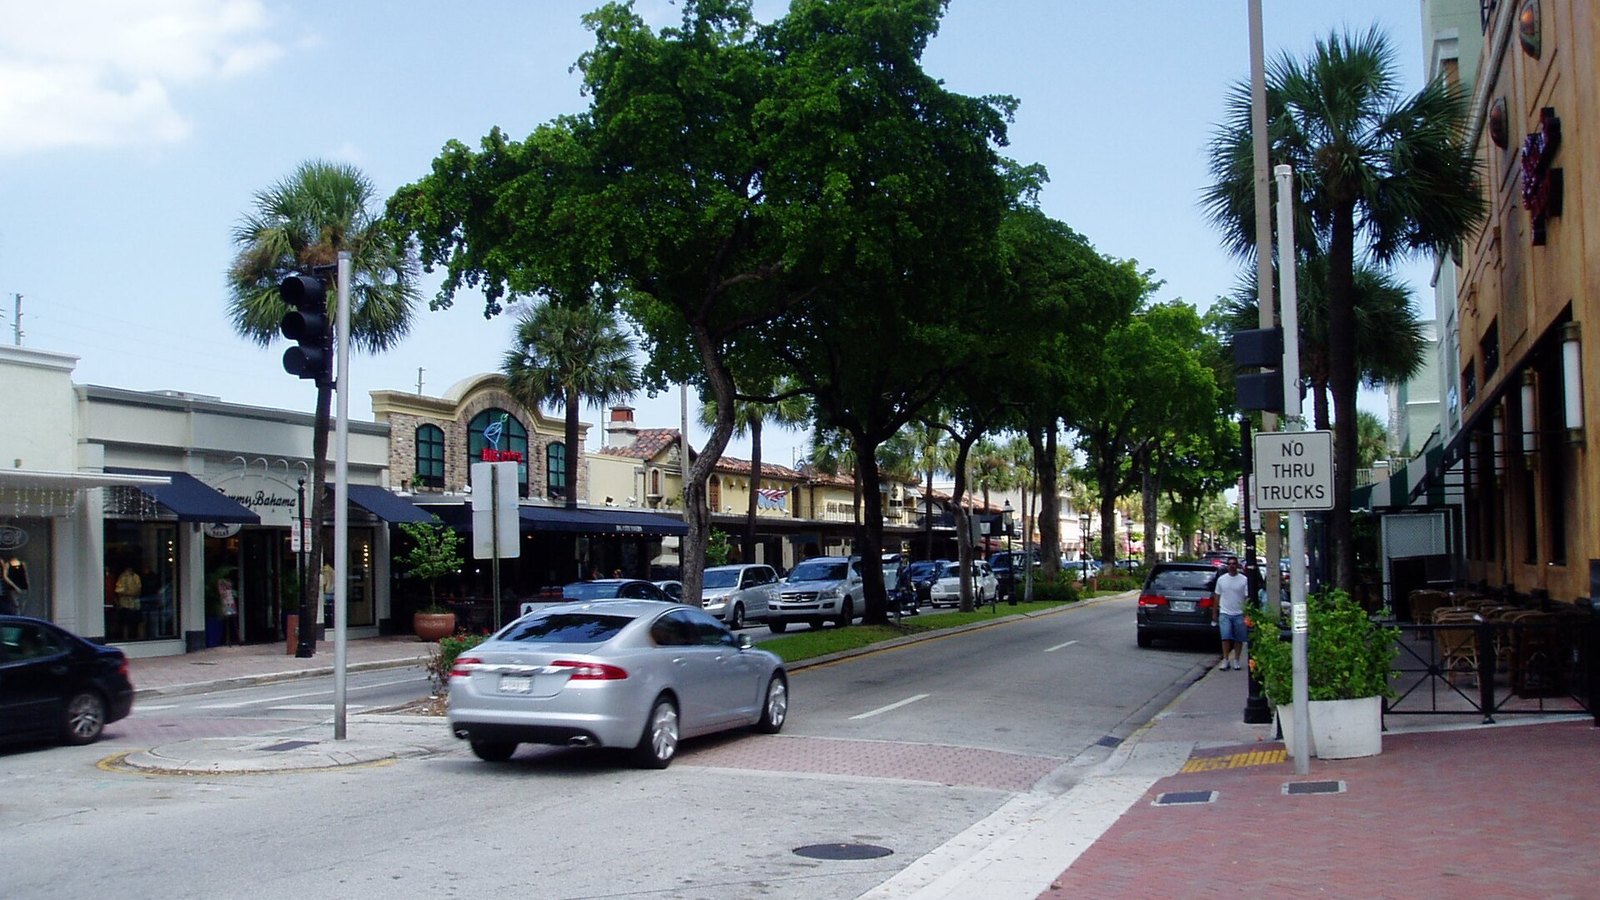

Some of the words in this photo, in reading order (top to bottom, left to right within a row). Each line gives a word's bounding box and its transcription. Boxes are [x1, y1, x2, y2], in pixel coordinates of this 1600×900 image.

[482, 448, 500, 461] BIG
[1281, 442, 1304, 457] NO
[1272, 463, 1315, 478] THRU
[252, 490, 297, 507] Bahama
[1261, 484, 1325, 500] TRUCKS
